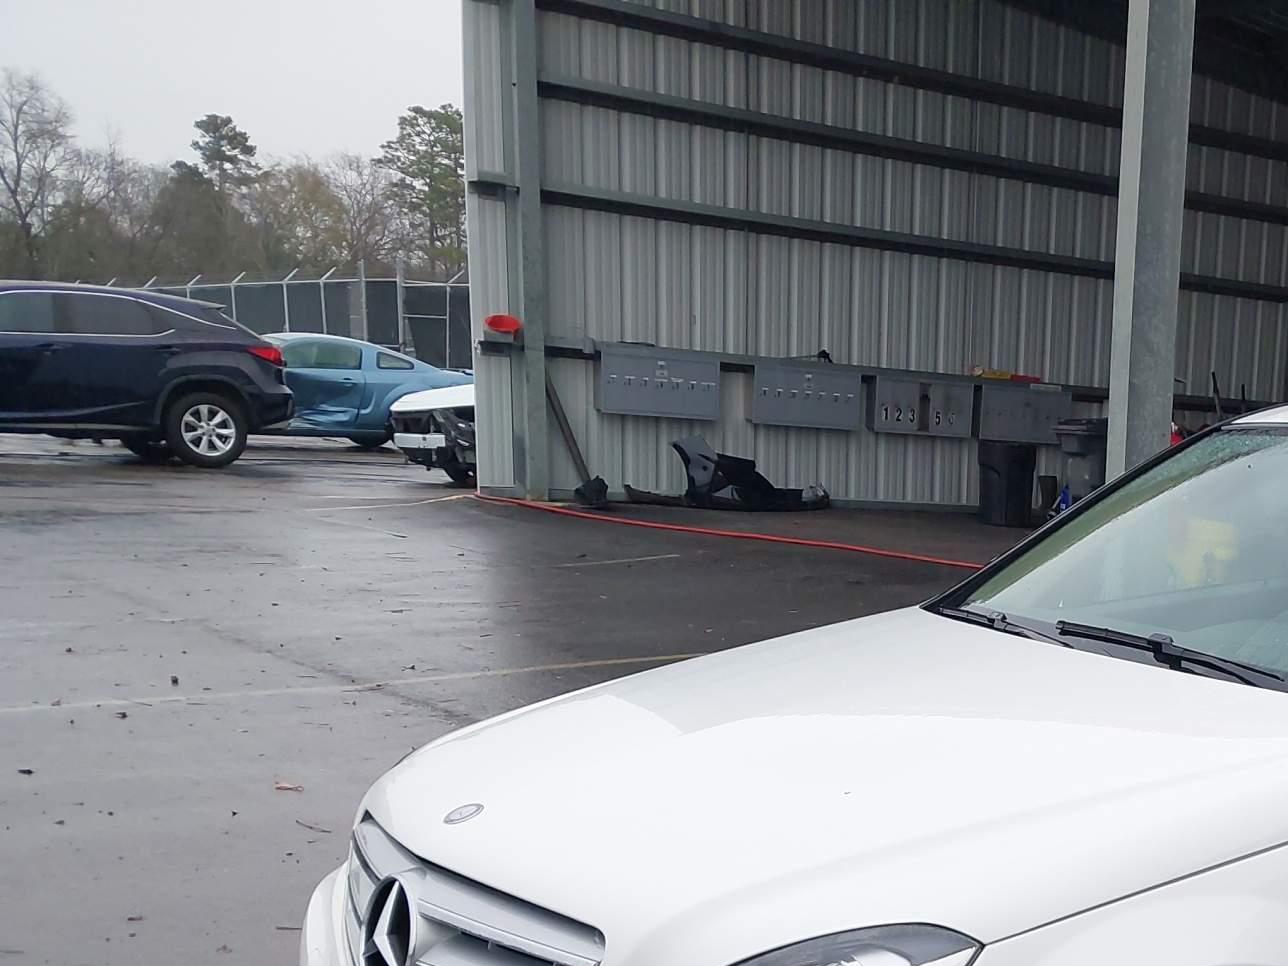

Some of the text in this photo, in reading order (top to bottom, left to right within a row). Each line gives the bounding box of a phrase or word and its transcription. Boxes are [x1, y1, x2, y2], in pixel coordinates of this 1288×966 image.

[883, 406, 916, 423] 1 2 3
[935, 411, 941, 426] 5
